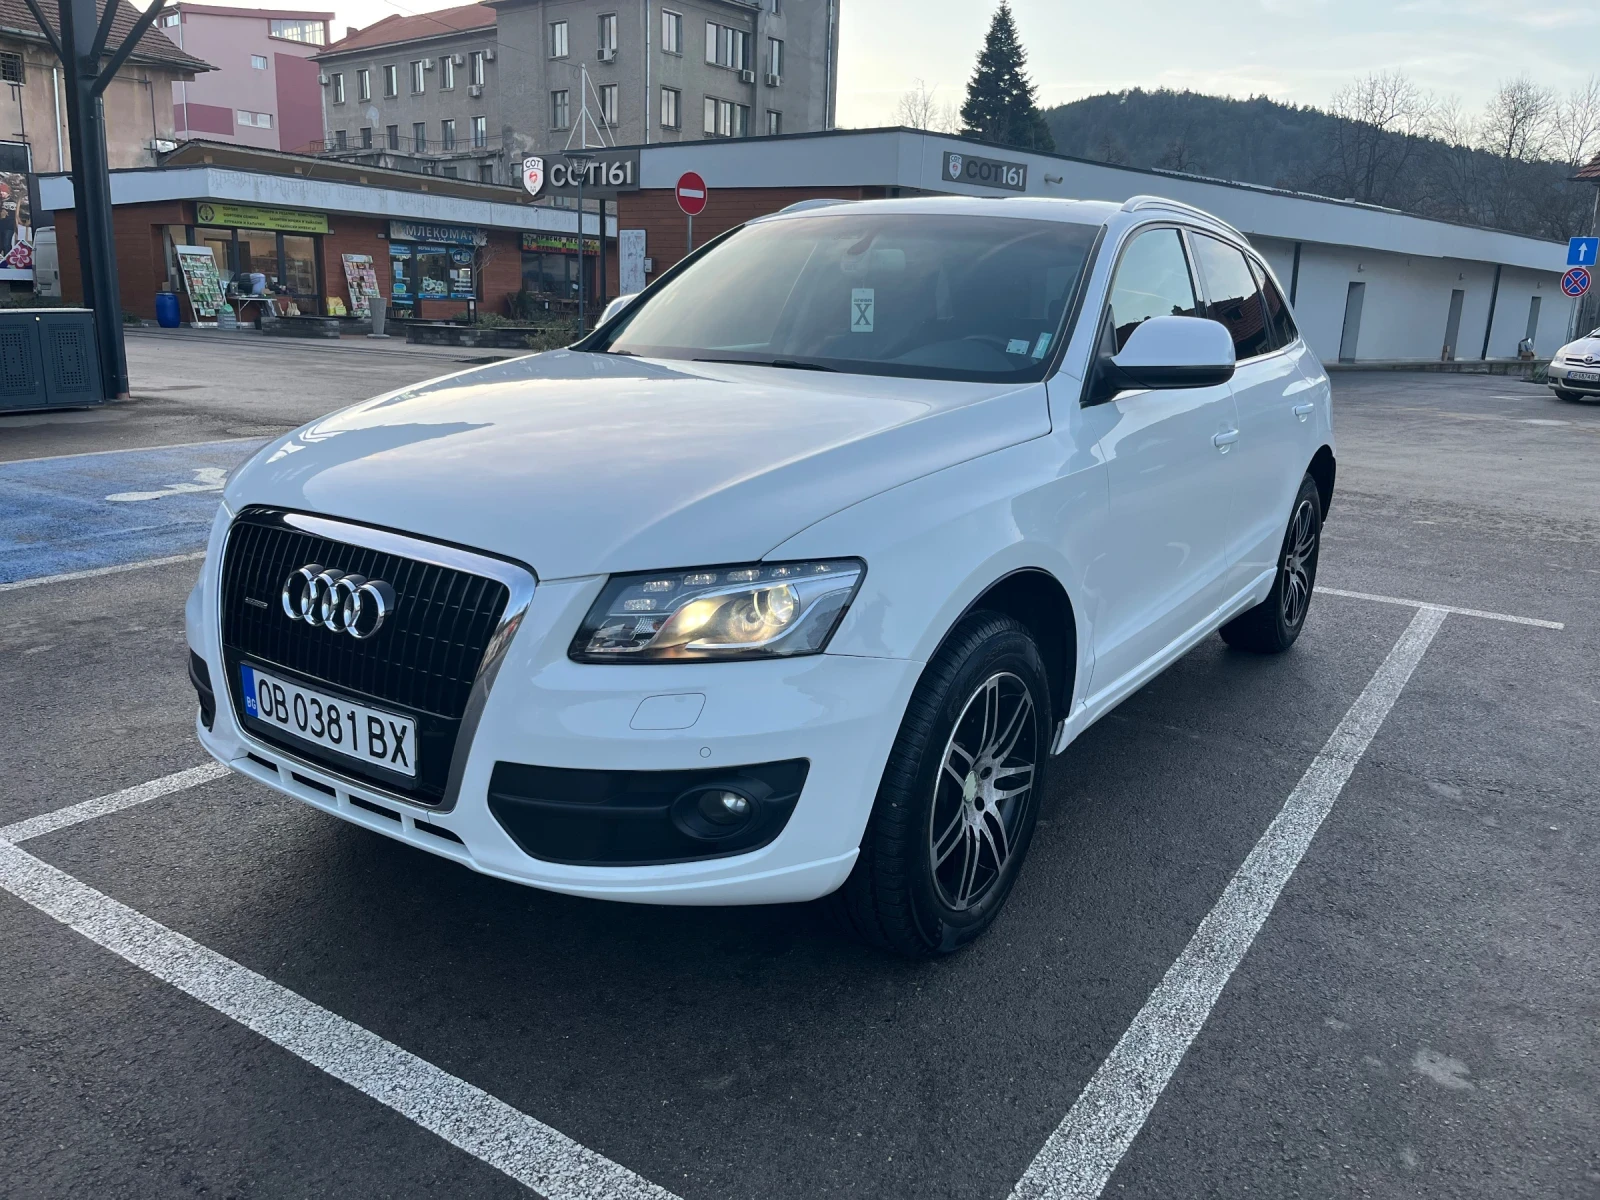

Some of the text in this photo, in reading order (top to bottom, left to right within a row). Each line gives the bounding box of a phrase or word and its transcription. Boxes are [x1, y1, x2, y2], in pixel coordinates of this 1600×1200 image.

[853, 303, 872, 325] X
[246, 696, 257, 710] BG
[258, 679, 409, 768] OB 0381 BX
